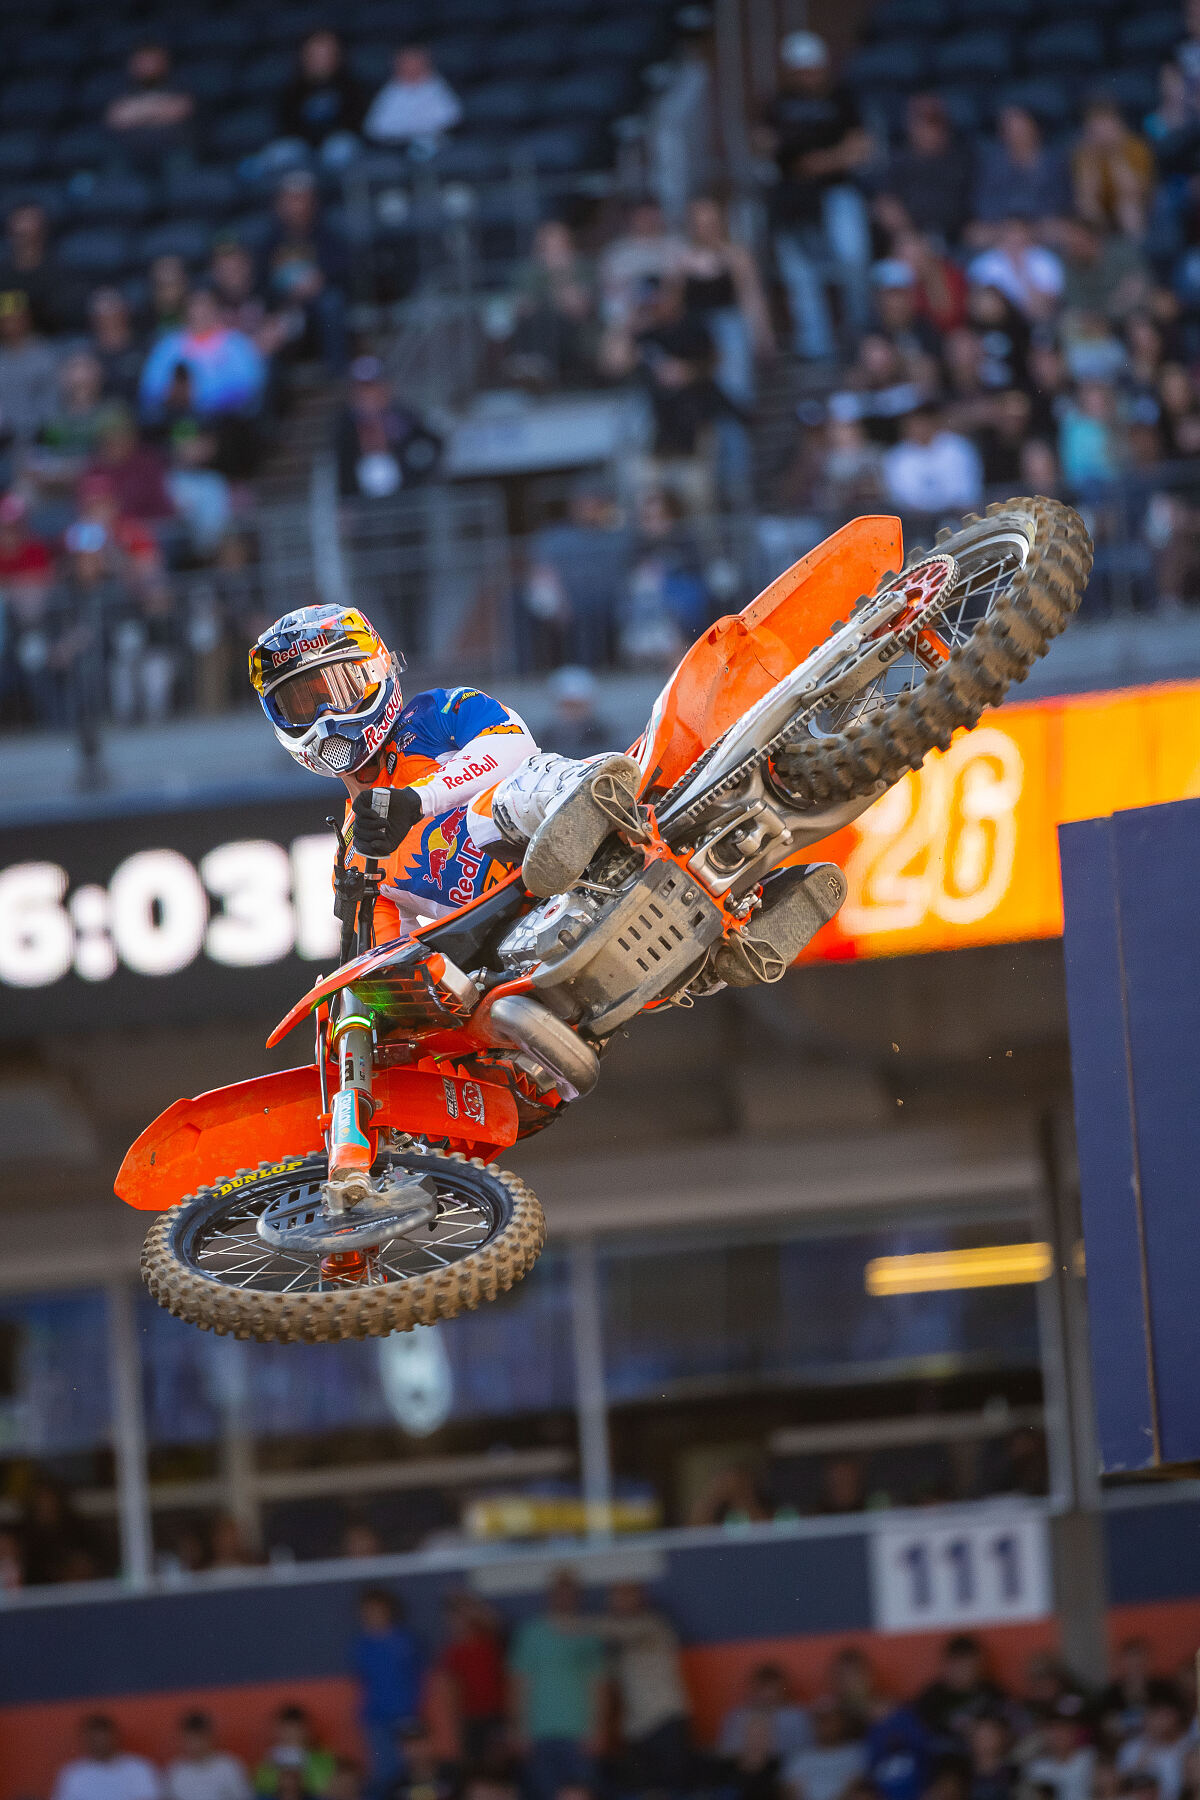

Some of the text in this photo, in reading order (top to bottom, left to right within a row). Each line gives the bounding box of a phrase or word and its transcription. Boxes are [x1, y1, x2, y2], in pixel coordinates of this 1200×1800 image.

[272, 633, 329, 668] Red Bull
[442, 754, 499, 790] Red Bull
[449, 852, 481, 906] Red
[219, 1161, 304, 1196] DUNLOP
[903, 1533, 1024, 1615] 111
